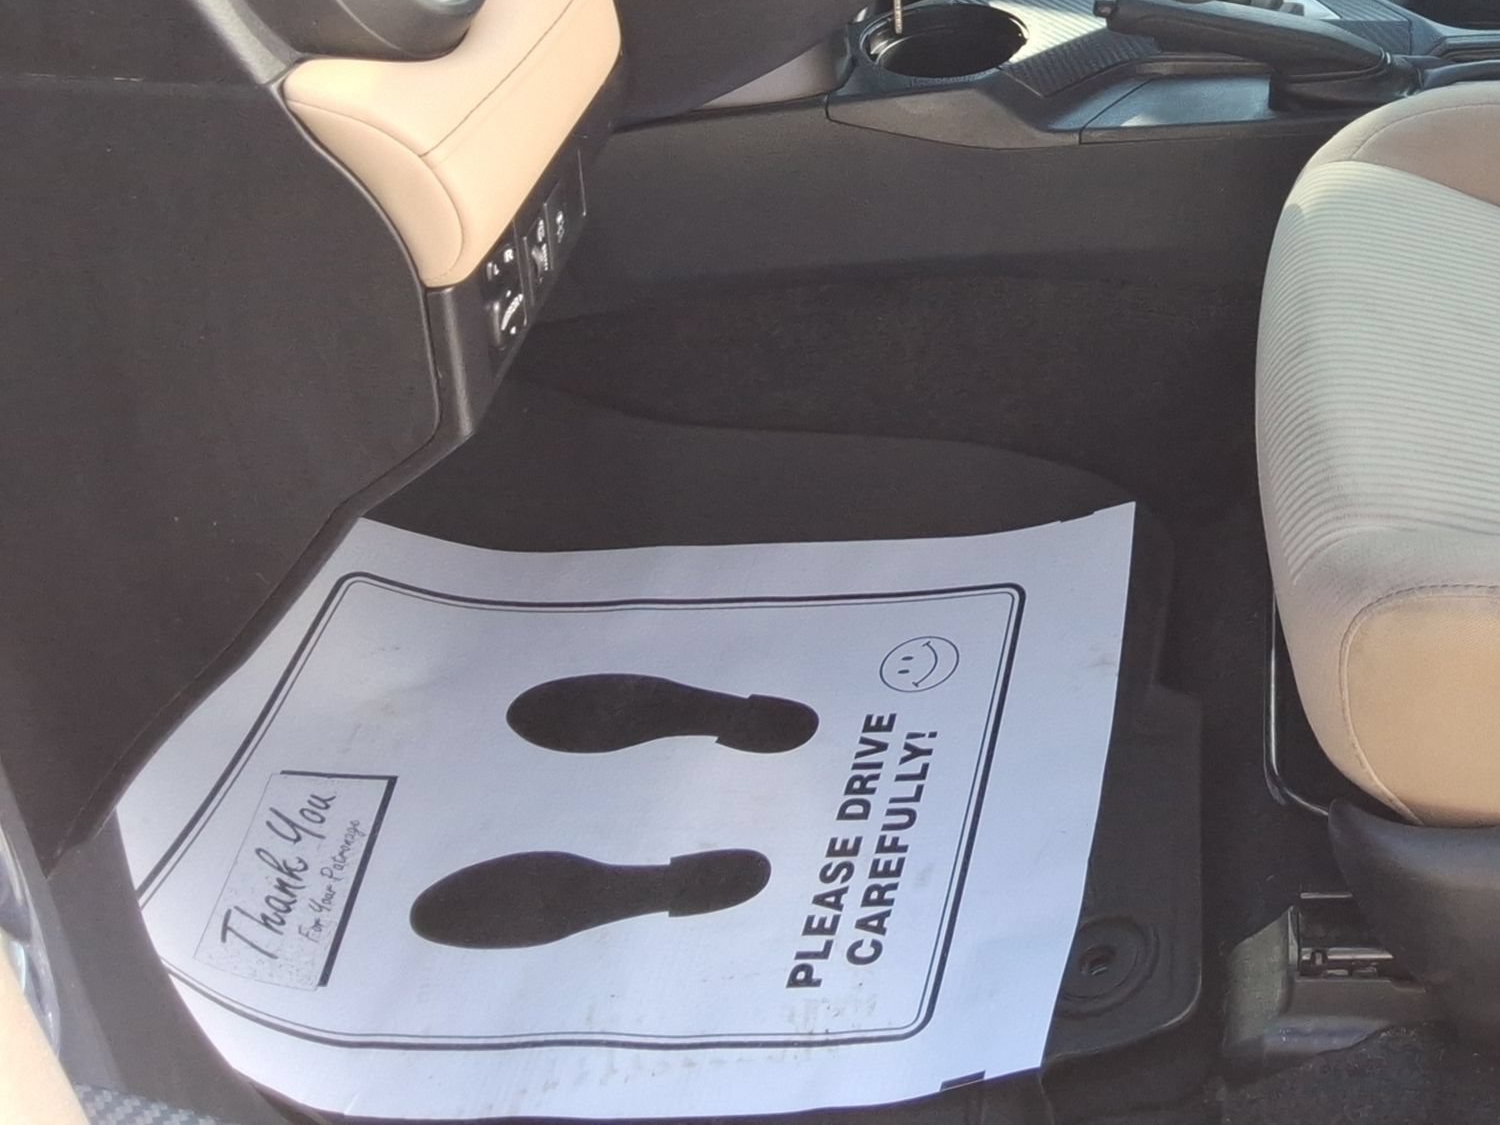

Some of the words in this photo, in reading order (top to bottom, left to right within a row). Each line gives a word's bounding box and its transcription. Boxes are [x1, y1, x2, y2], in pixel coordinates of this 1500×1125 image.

[504, 249, 514, 263] R
[220, 847, 309, 960] Thank
[265, 791, 337, 845] You
[298, 917, 325, 943] For
[320, 819, 367, 882] Patronage
[786, 836, 863, 989] PLEASE
[836, 713, 897, 821] DRIVE
[846, 731, 938, 966] CAREFULLY!
